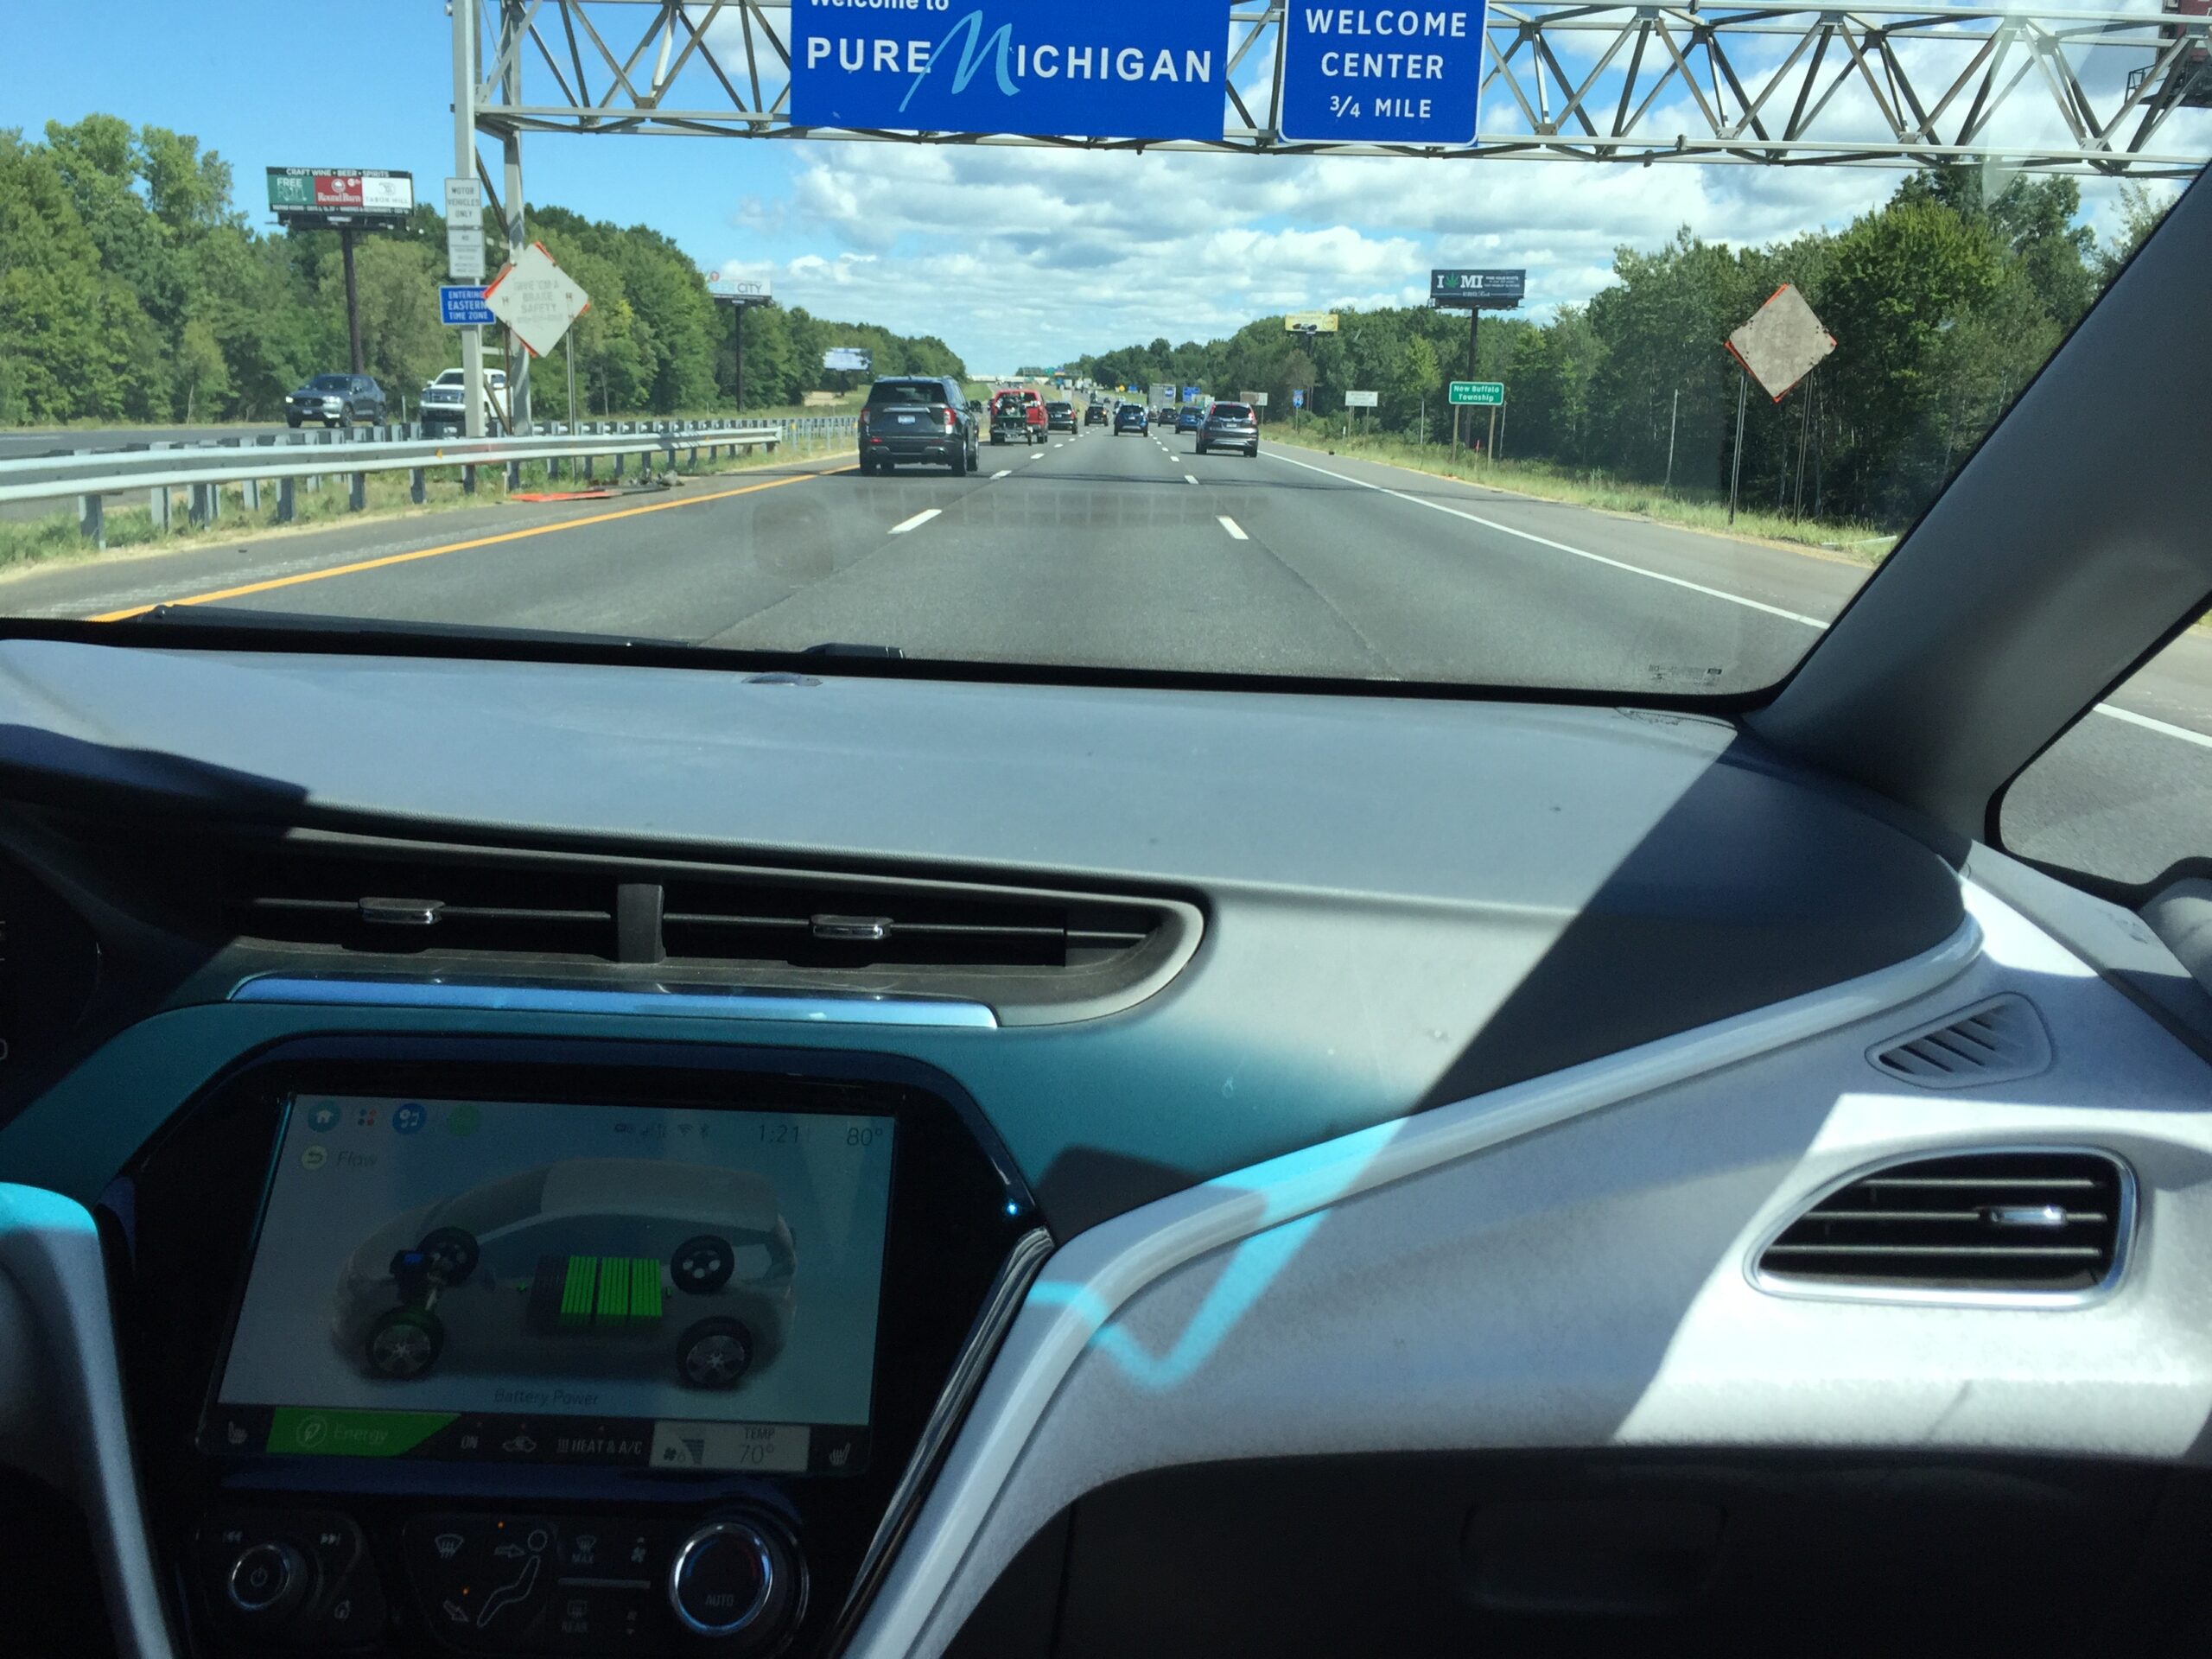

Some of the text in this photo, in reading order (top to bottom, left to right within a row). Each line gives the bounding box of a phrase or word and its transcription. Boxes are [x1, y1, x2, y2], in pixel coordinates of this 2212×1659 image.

[1305, 8, 1467, 38] WELCOME
[806, 36, 932, 74] PURE
[1320, 51, 1445, 79] CENTER
[1329, 95, 1432, 118] 3/4 MILE
[286, 168, 311, 176] CRAFT
[276, 177, 302, 187] FREE
[737, 283, 762, 294] CITY
[1436, 275, 1445, 289] I
[1460, 275, 1484, 289] MI
[448, 301, 487, 311] EASTERN
[448, 311, 487, 320] TIME ZONE
[1459, 393, 1494, 403] Township
[759, 1123, 800, 1144] 1:21
[336, 1149, 378, 1167] Flow
[493, 1387, 600, 1408] Battery Power
[334, 1422, 390, 1446] Energy
[744, 1426, 776, 1440] TEMP
[571, 1438, 603, 1454] HEAT
[618, 1440, 643, 1456] A/C
[704, 1593, 734, 1607] AUTO
